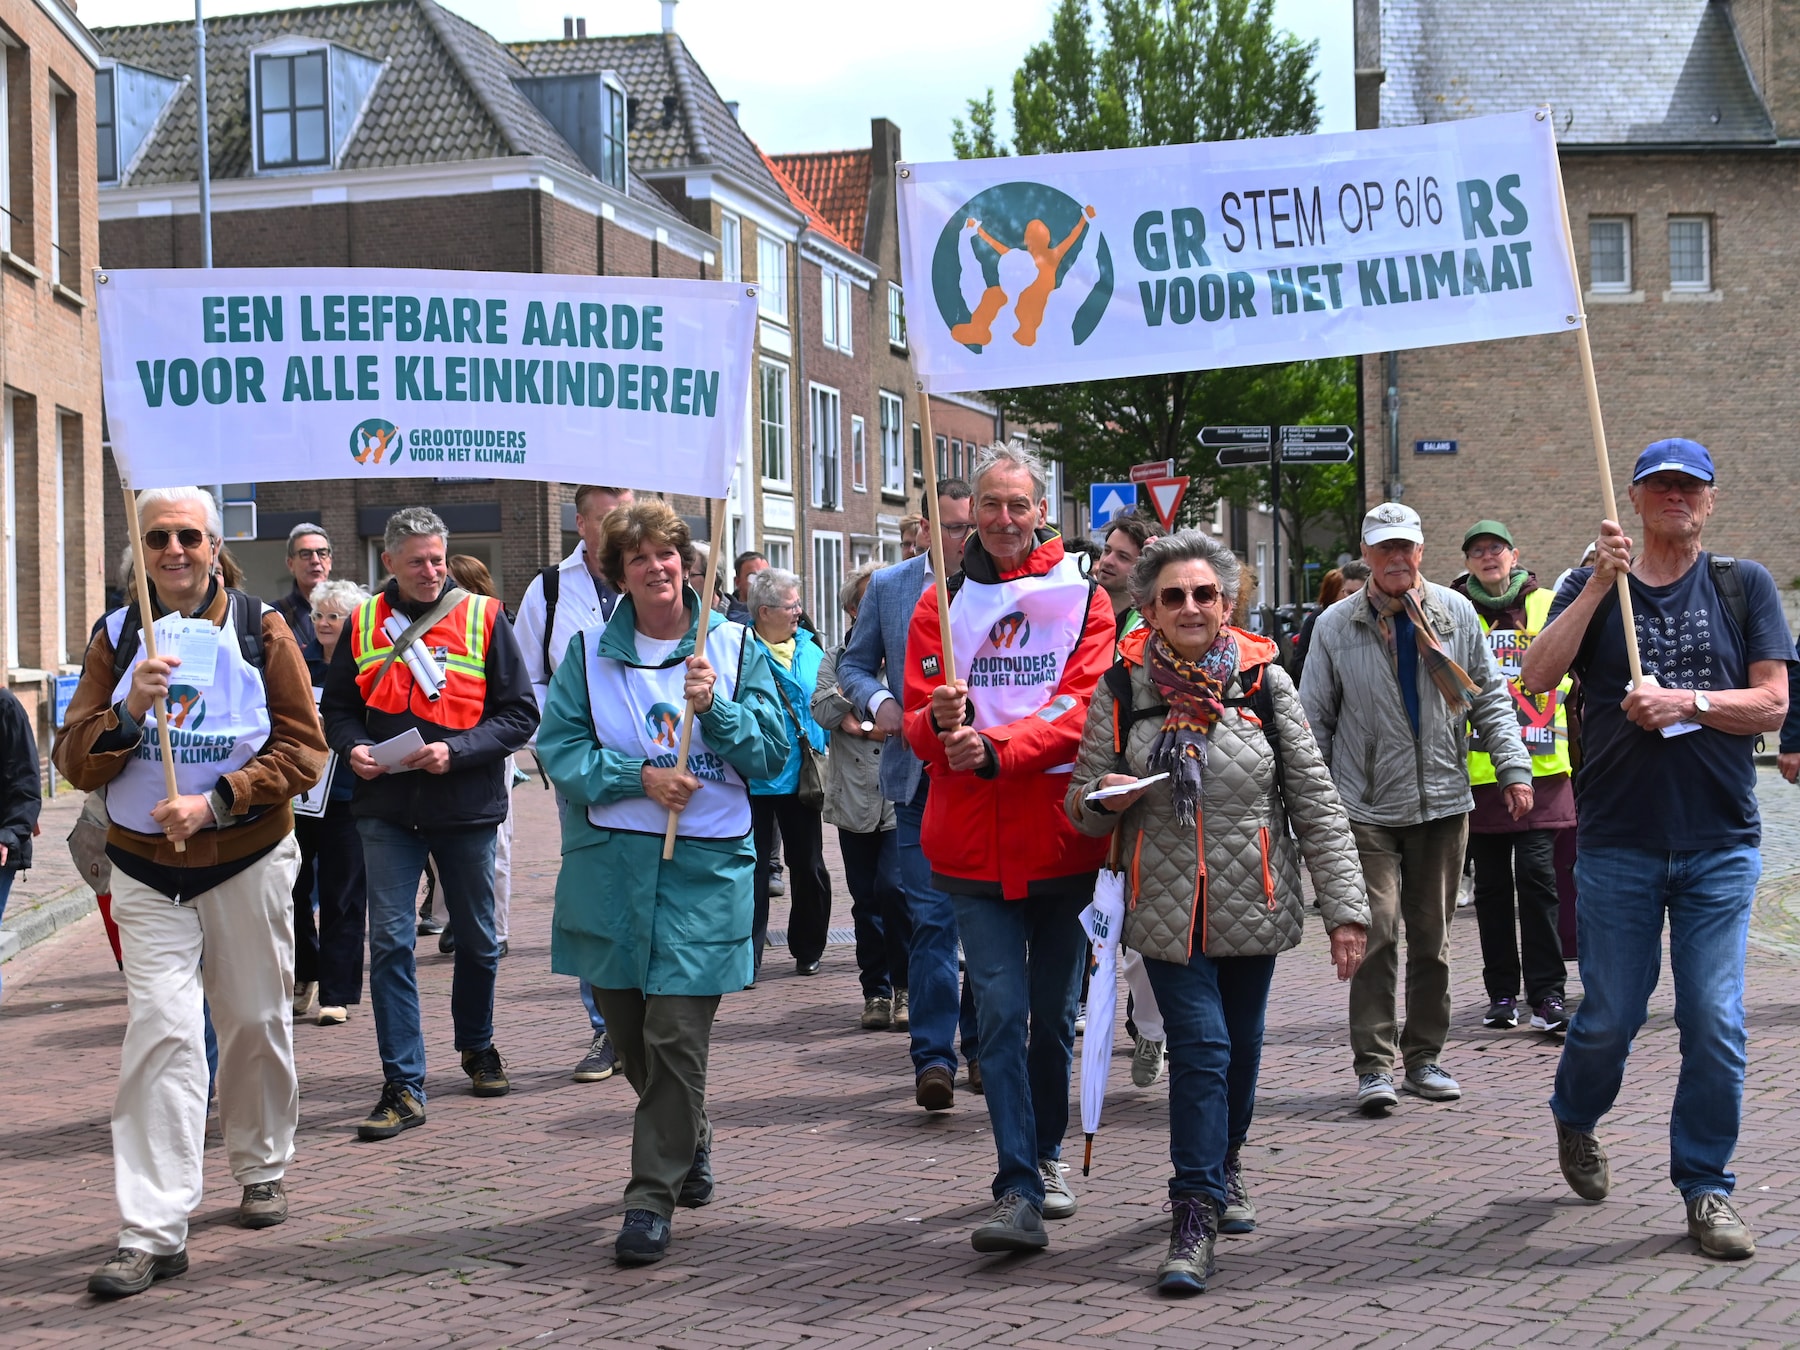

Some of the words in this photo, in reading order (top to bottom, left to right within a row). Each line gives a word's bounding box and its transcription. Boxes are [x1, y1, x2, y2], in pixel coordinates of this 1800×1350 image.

[1221, 186, 1325, 252] STEM
[1339, 181, 1384, 233] OP
[1395, 176, 1442, 228] 6/6
[1138, 271, 1257, 326] VOOR
[1267, 263, 1342, 315] HET
[1357, 241, 1532, 306] KLIMAAT
[203, 295, 283, 343] EEN
[300, 295, 507, 344] LEEFBARE
[522, 301, 663, 351] AARDE
[136, 357, 266, 407] VOOR
[282, 355, 379, 401] ALLE
[395, 355, 719, 417] KLEINKINDEREN
[409, 429, 527, 448] GROOTOUDERS
[410, 448, 444, 462] VOOR
[448, 448, 471, 462] HET
[475, 449, 526, 464] KLIMAAT
[971, 652, 1056, 673] ROOTOUDERS
[992, 673, 1011, 687] HET
[1014, 669, 1056, 686] KLIMAAT
[1526, 726, 1553, 743] NIE!
